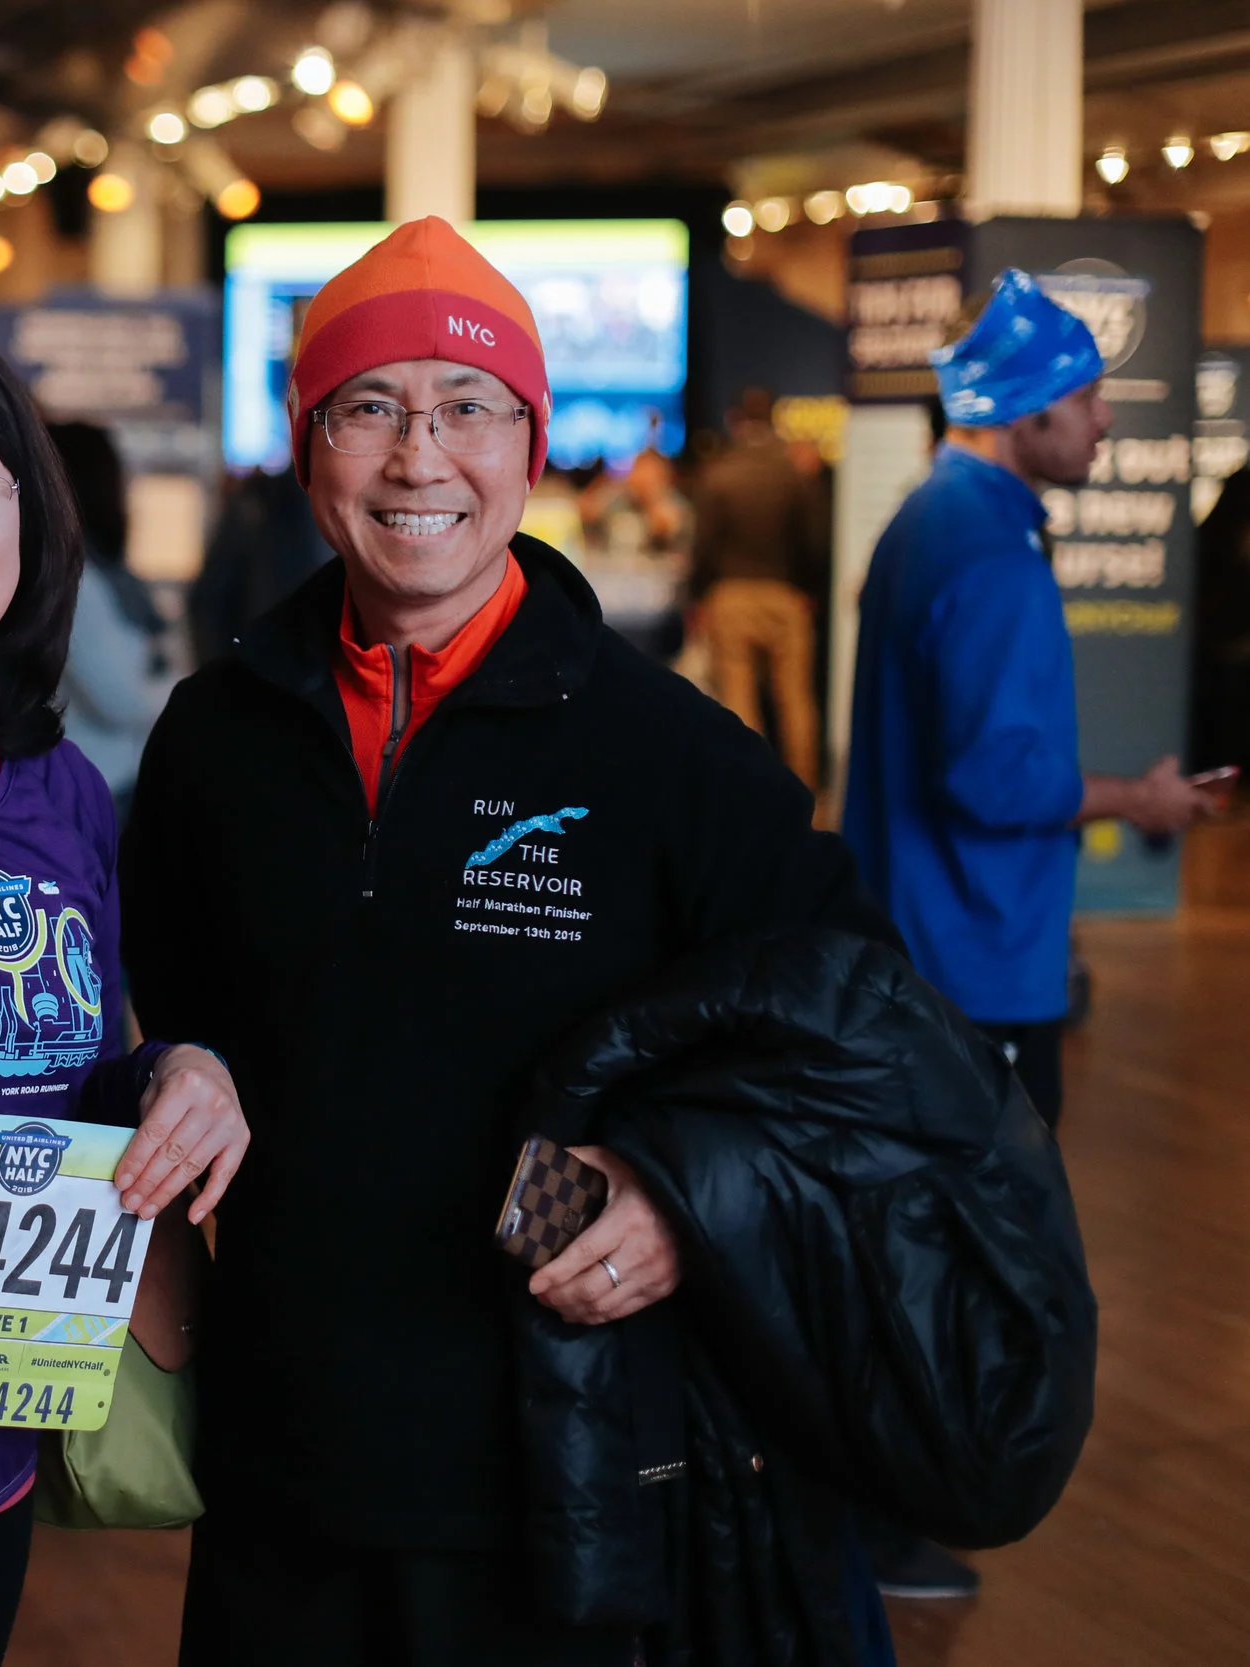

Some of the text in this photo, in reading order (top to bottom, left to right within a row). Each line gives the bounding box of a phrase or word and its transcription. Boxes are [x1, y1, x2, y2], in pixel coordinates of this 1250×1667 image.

[448, 315, 496, 347] NYC
[473, 799, 515, 816] RUN
[519, 844, 560, 864] THE
[463, 869, 583, 897] RESERVOIR
[456, 897, 593, 921] Half Marathon Finisher
[454, 919, 582, 941] September 13th 2015
[1, 1087, 19, 1096] YORK
[20, 1085, 39, 1094] ROAD
[40, 1083, 69, 1093] RUNNERS
[33, 1137, 66, 1146] AIRLINES
[4, 1145, 53, 1168] NYC
[4, 1166, 45, 1183] HALF
[11, 1185, 33, 1193] 2018
[18, 1316, 28, 1333] 1
[31, 1358, 104, 1371] #UnitedNYCHalf
